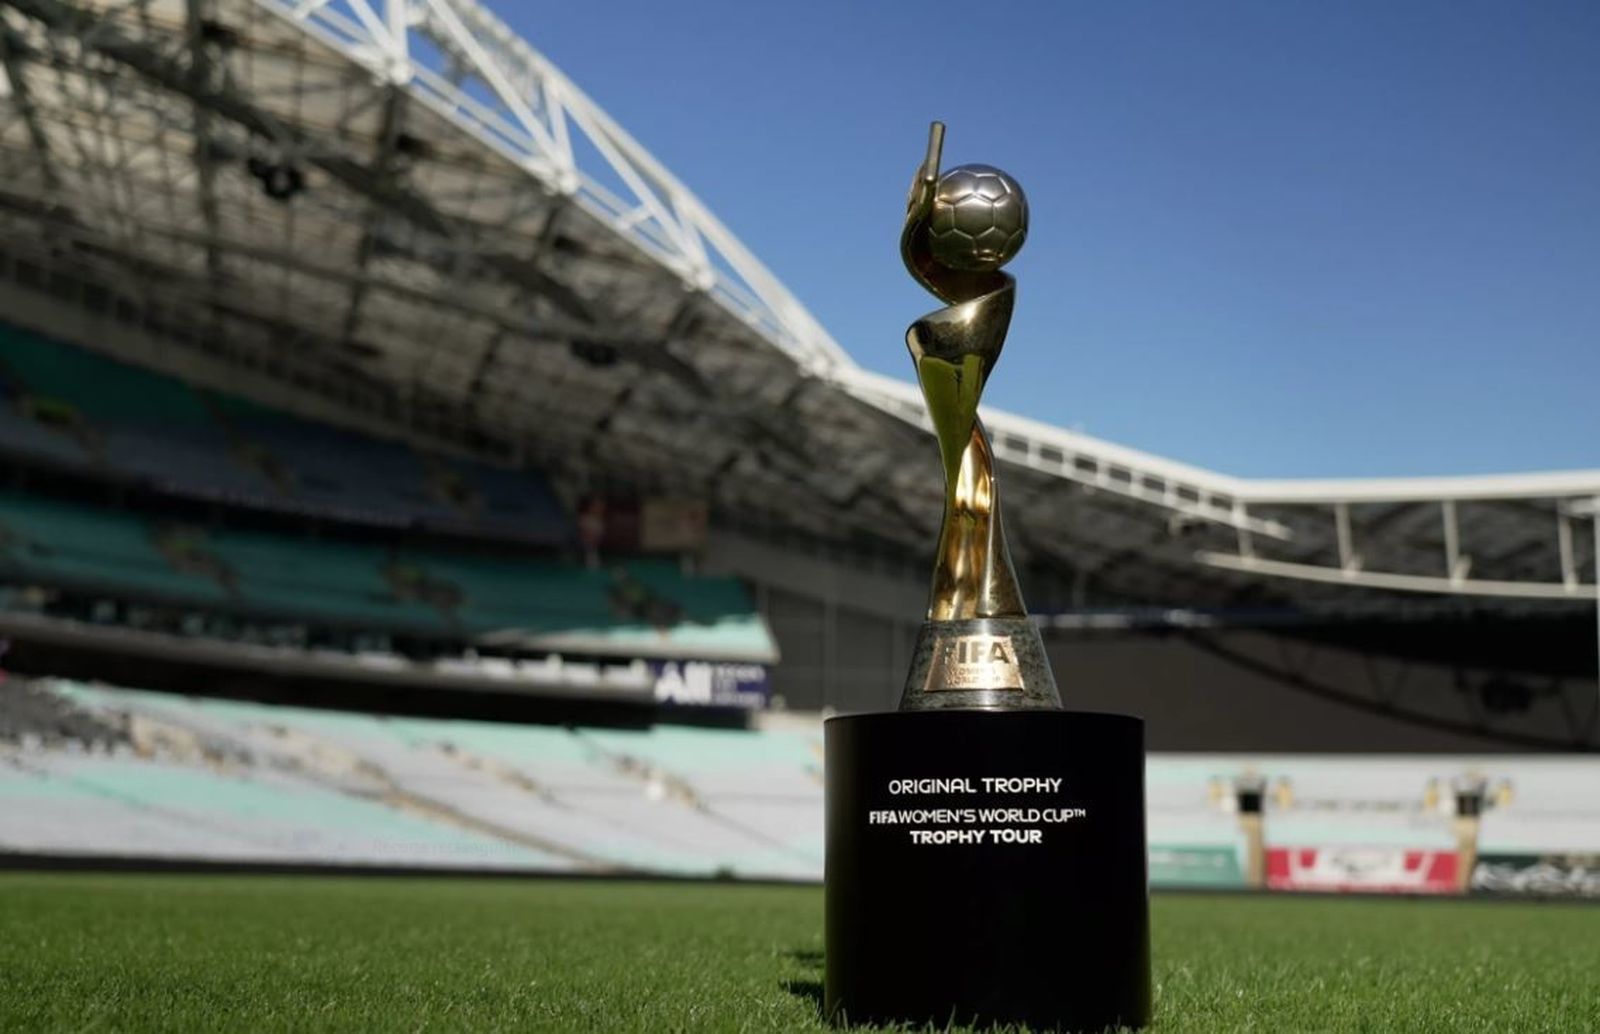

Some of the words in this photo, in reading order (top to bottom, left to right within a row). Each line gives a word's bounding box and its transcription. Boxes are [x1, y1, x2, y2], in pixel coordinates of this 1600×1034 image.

[941, 640, 1011, 664] FIFA
[888, 777, 977, 795] ORIGINAL
[980, 777, 1062, 793] TROPHY
[869, 810, 898, 824] FIFA
[899, 808, 976, 824] WOMEN'S
[978, 808, 1040, 823] WORLD
[909, 829, 986, 844] TROPHY
[989, 828, 1042, 843] TOUR
